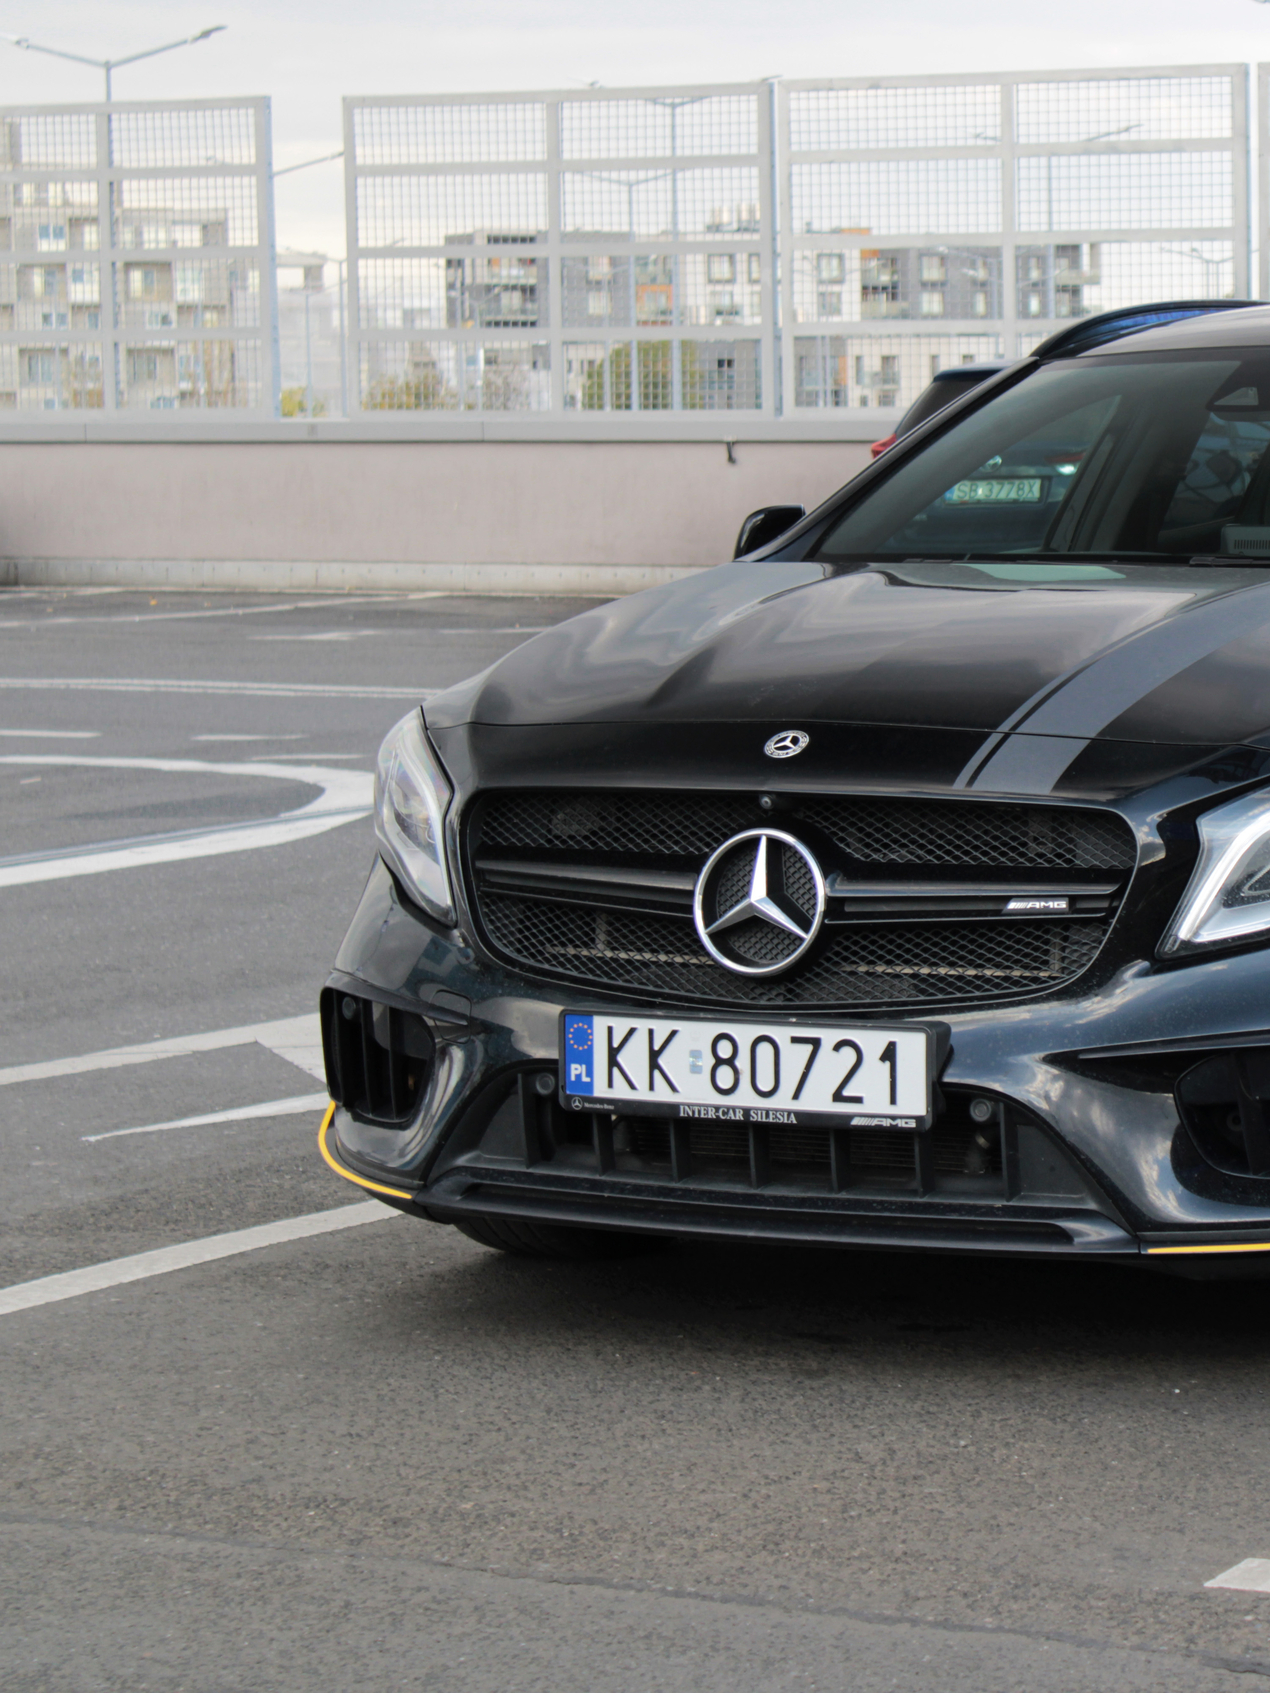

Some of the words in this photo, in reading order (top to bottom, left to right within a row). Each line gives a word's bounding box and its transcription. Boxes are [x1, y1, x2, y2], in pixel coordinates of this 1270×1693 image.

[957, 482, 979, 499] SB
[985, 481, 1037, 499] 3778X
[1026, 901, 1067, 909] AMG
[570, 1063, 592, 1083] PL
[606, 1025, 681, 1094] KK
[709, 1031, 899, 1106] 80721
[679, 1104, 744, 1121] INTER-CAR
[749, 1108, 797, 1124] SILESIA
[873, 1117, 916, 1128] AMG
